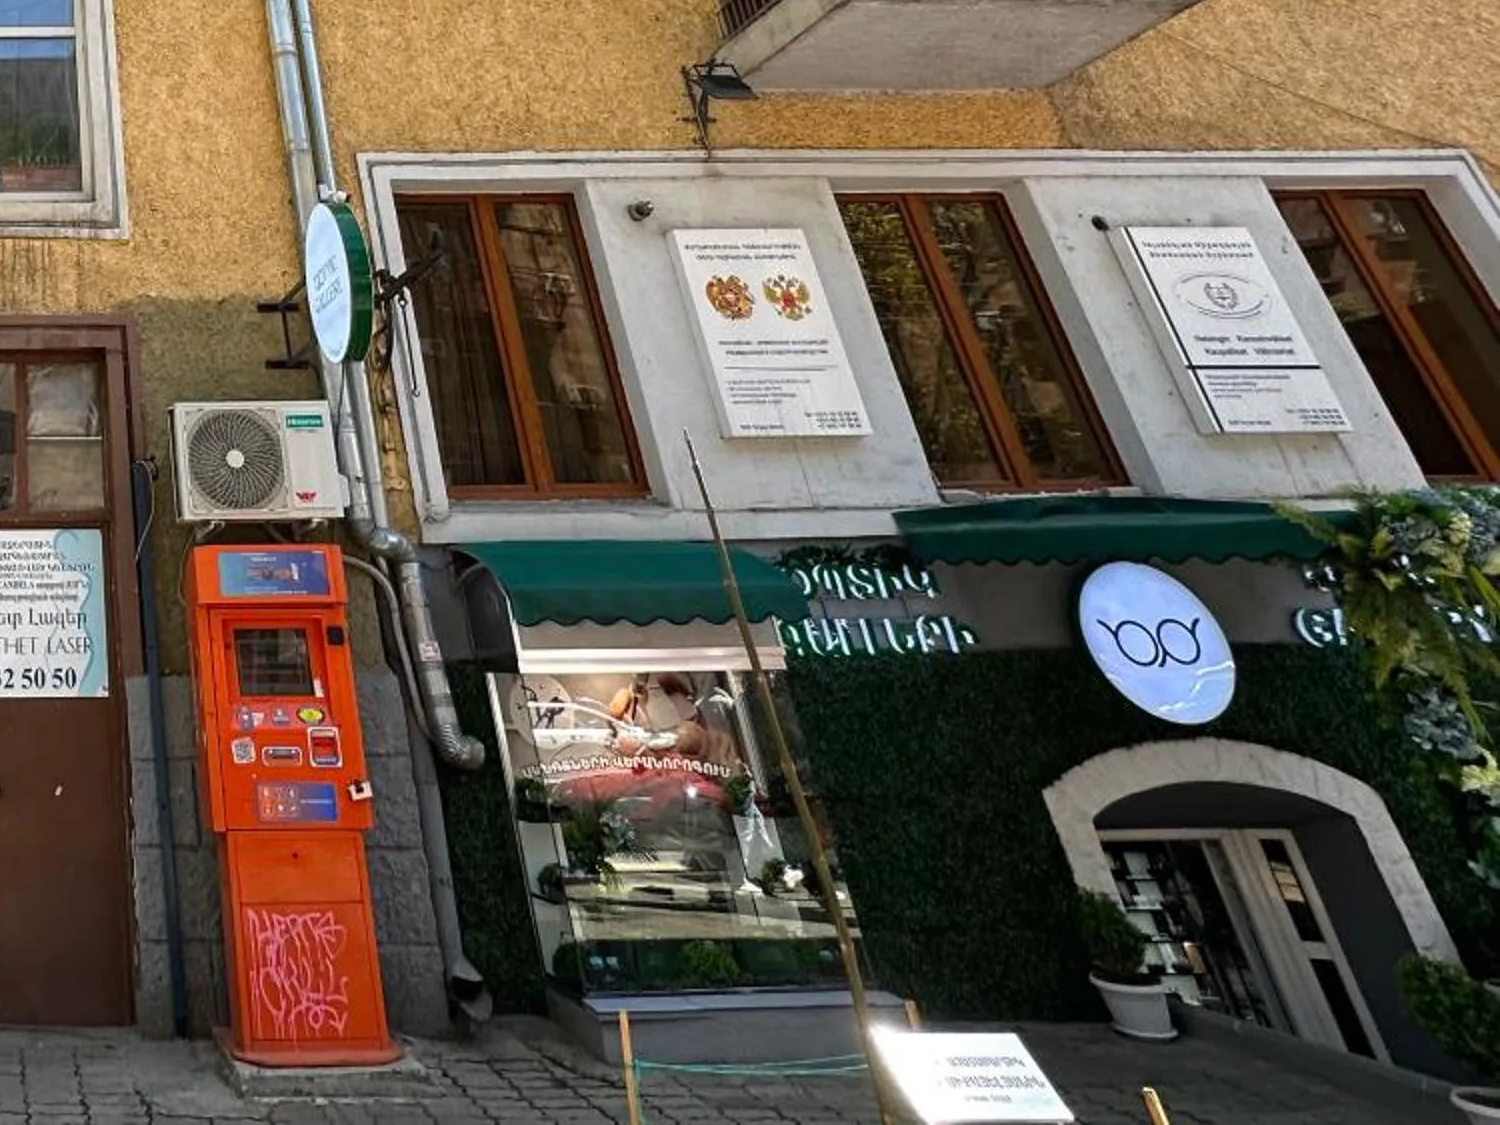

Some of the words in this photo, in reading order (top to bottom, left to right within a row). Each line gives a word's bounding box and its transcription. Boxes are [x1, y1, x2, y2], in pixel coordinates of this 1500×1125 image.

[47, 636, 94, 655] LASER
[22, 668, 46, 690] 50
[52, 668, 77, 690] 50
